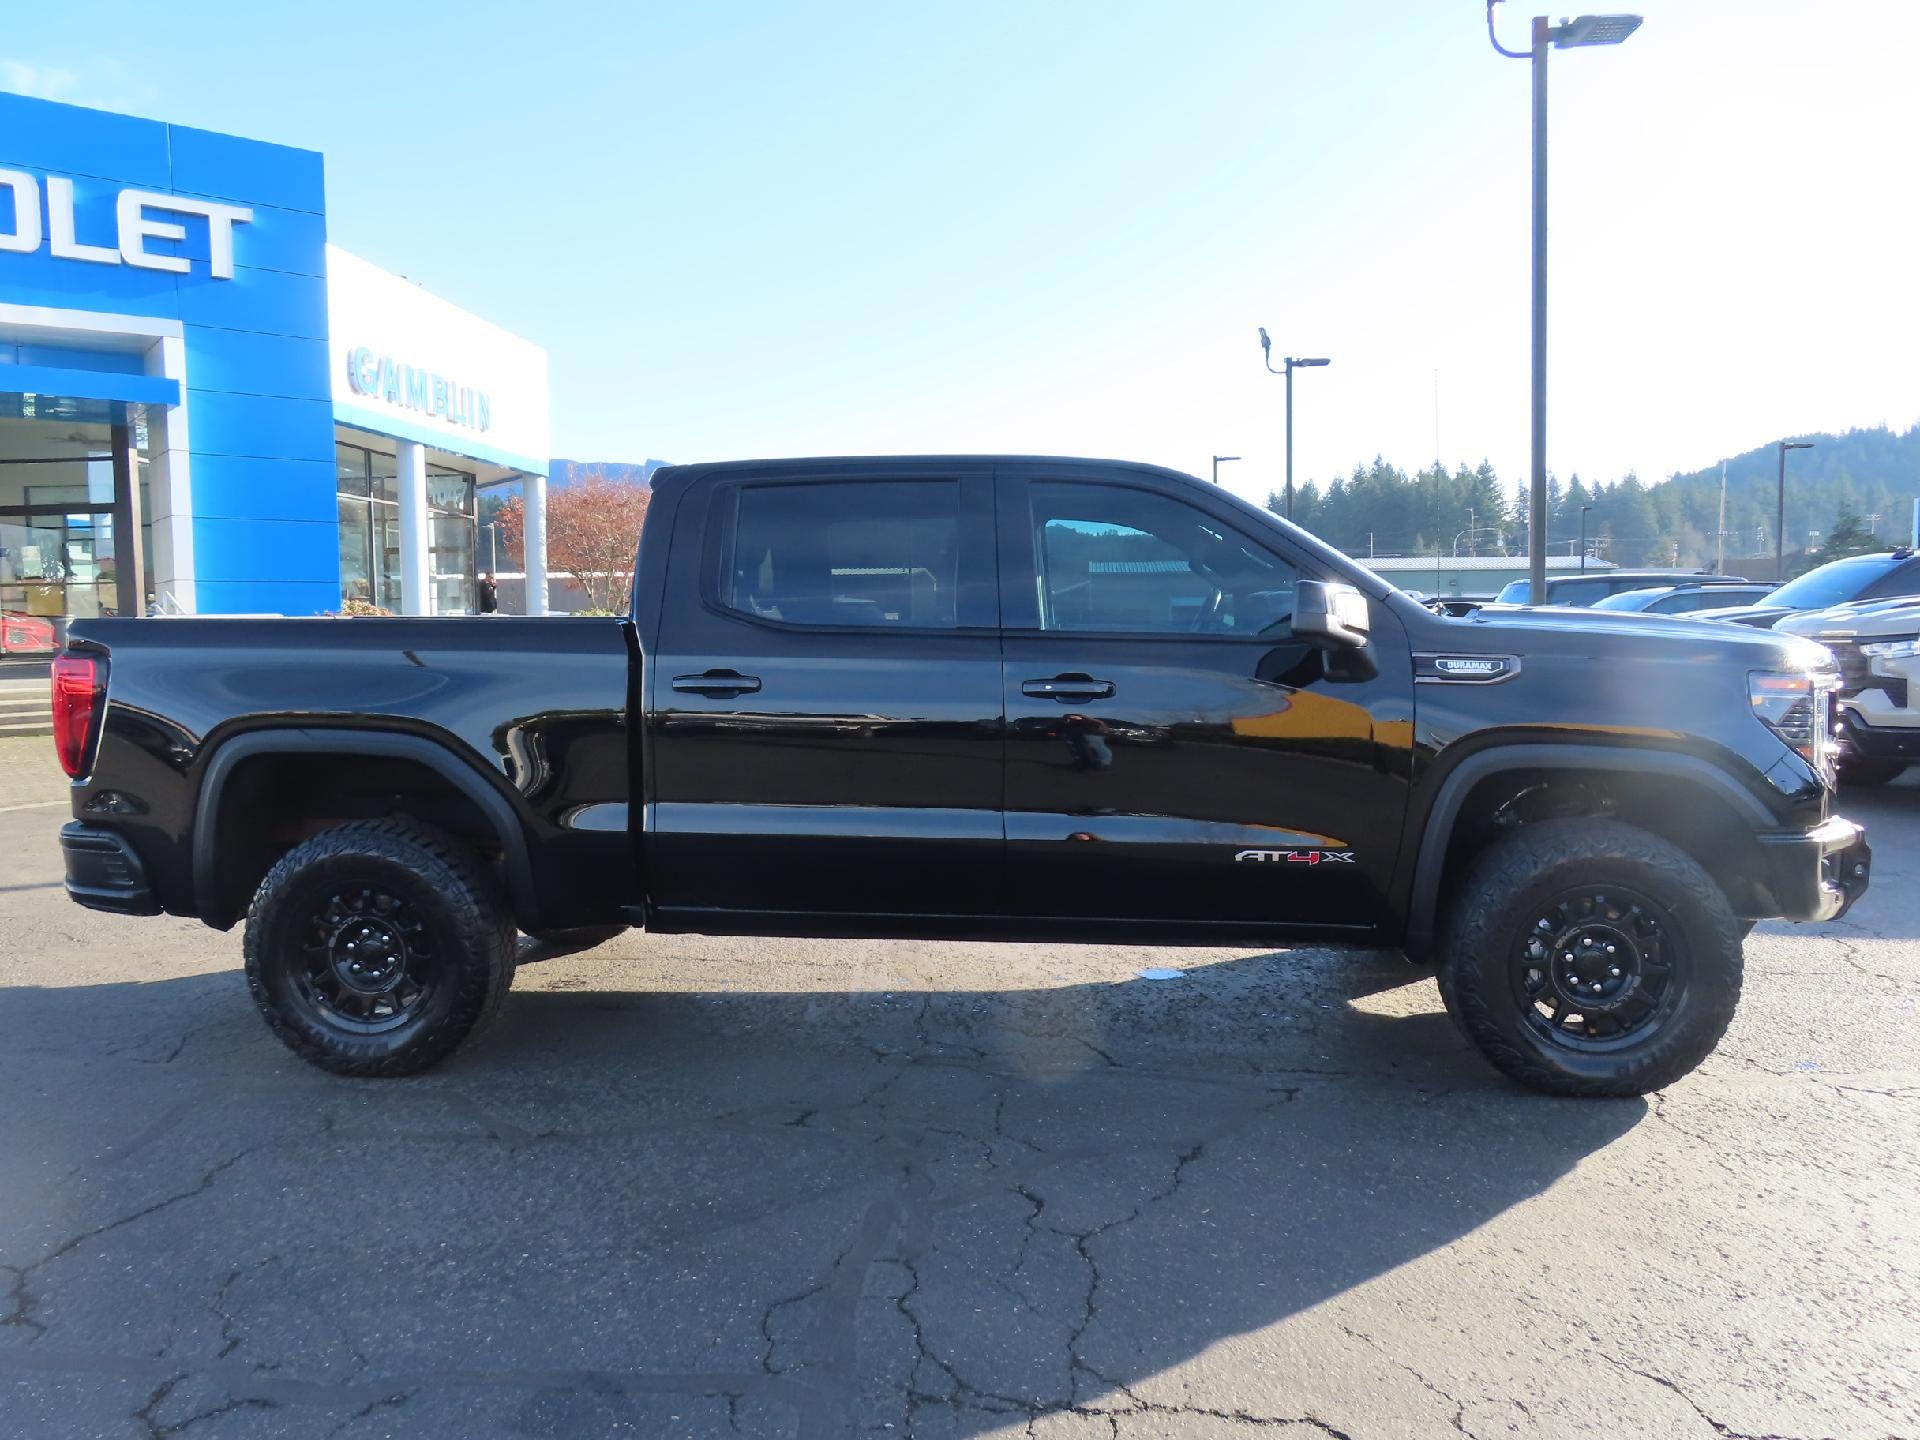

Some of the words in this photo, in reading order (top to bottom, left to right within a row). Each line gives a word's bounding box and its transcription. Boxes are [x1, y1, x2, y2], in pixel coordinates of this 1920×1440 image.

[347, 347, 490, 432] GAMBLIN
[1447, 660, 1492, 670] DURAMAX
[1235, 850, 1356, 865] AT4X
